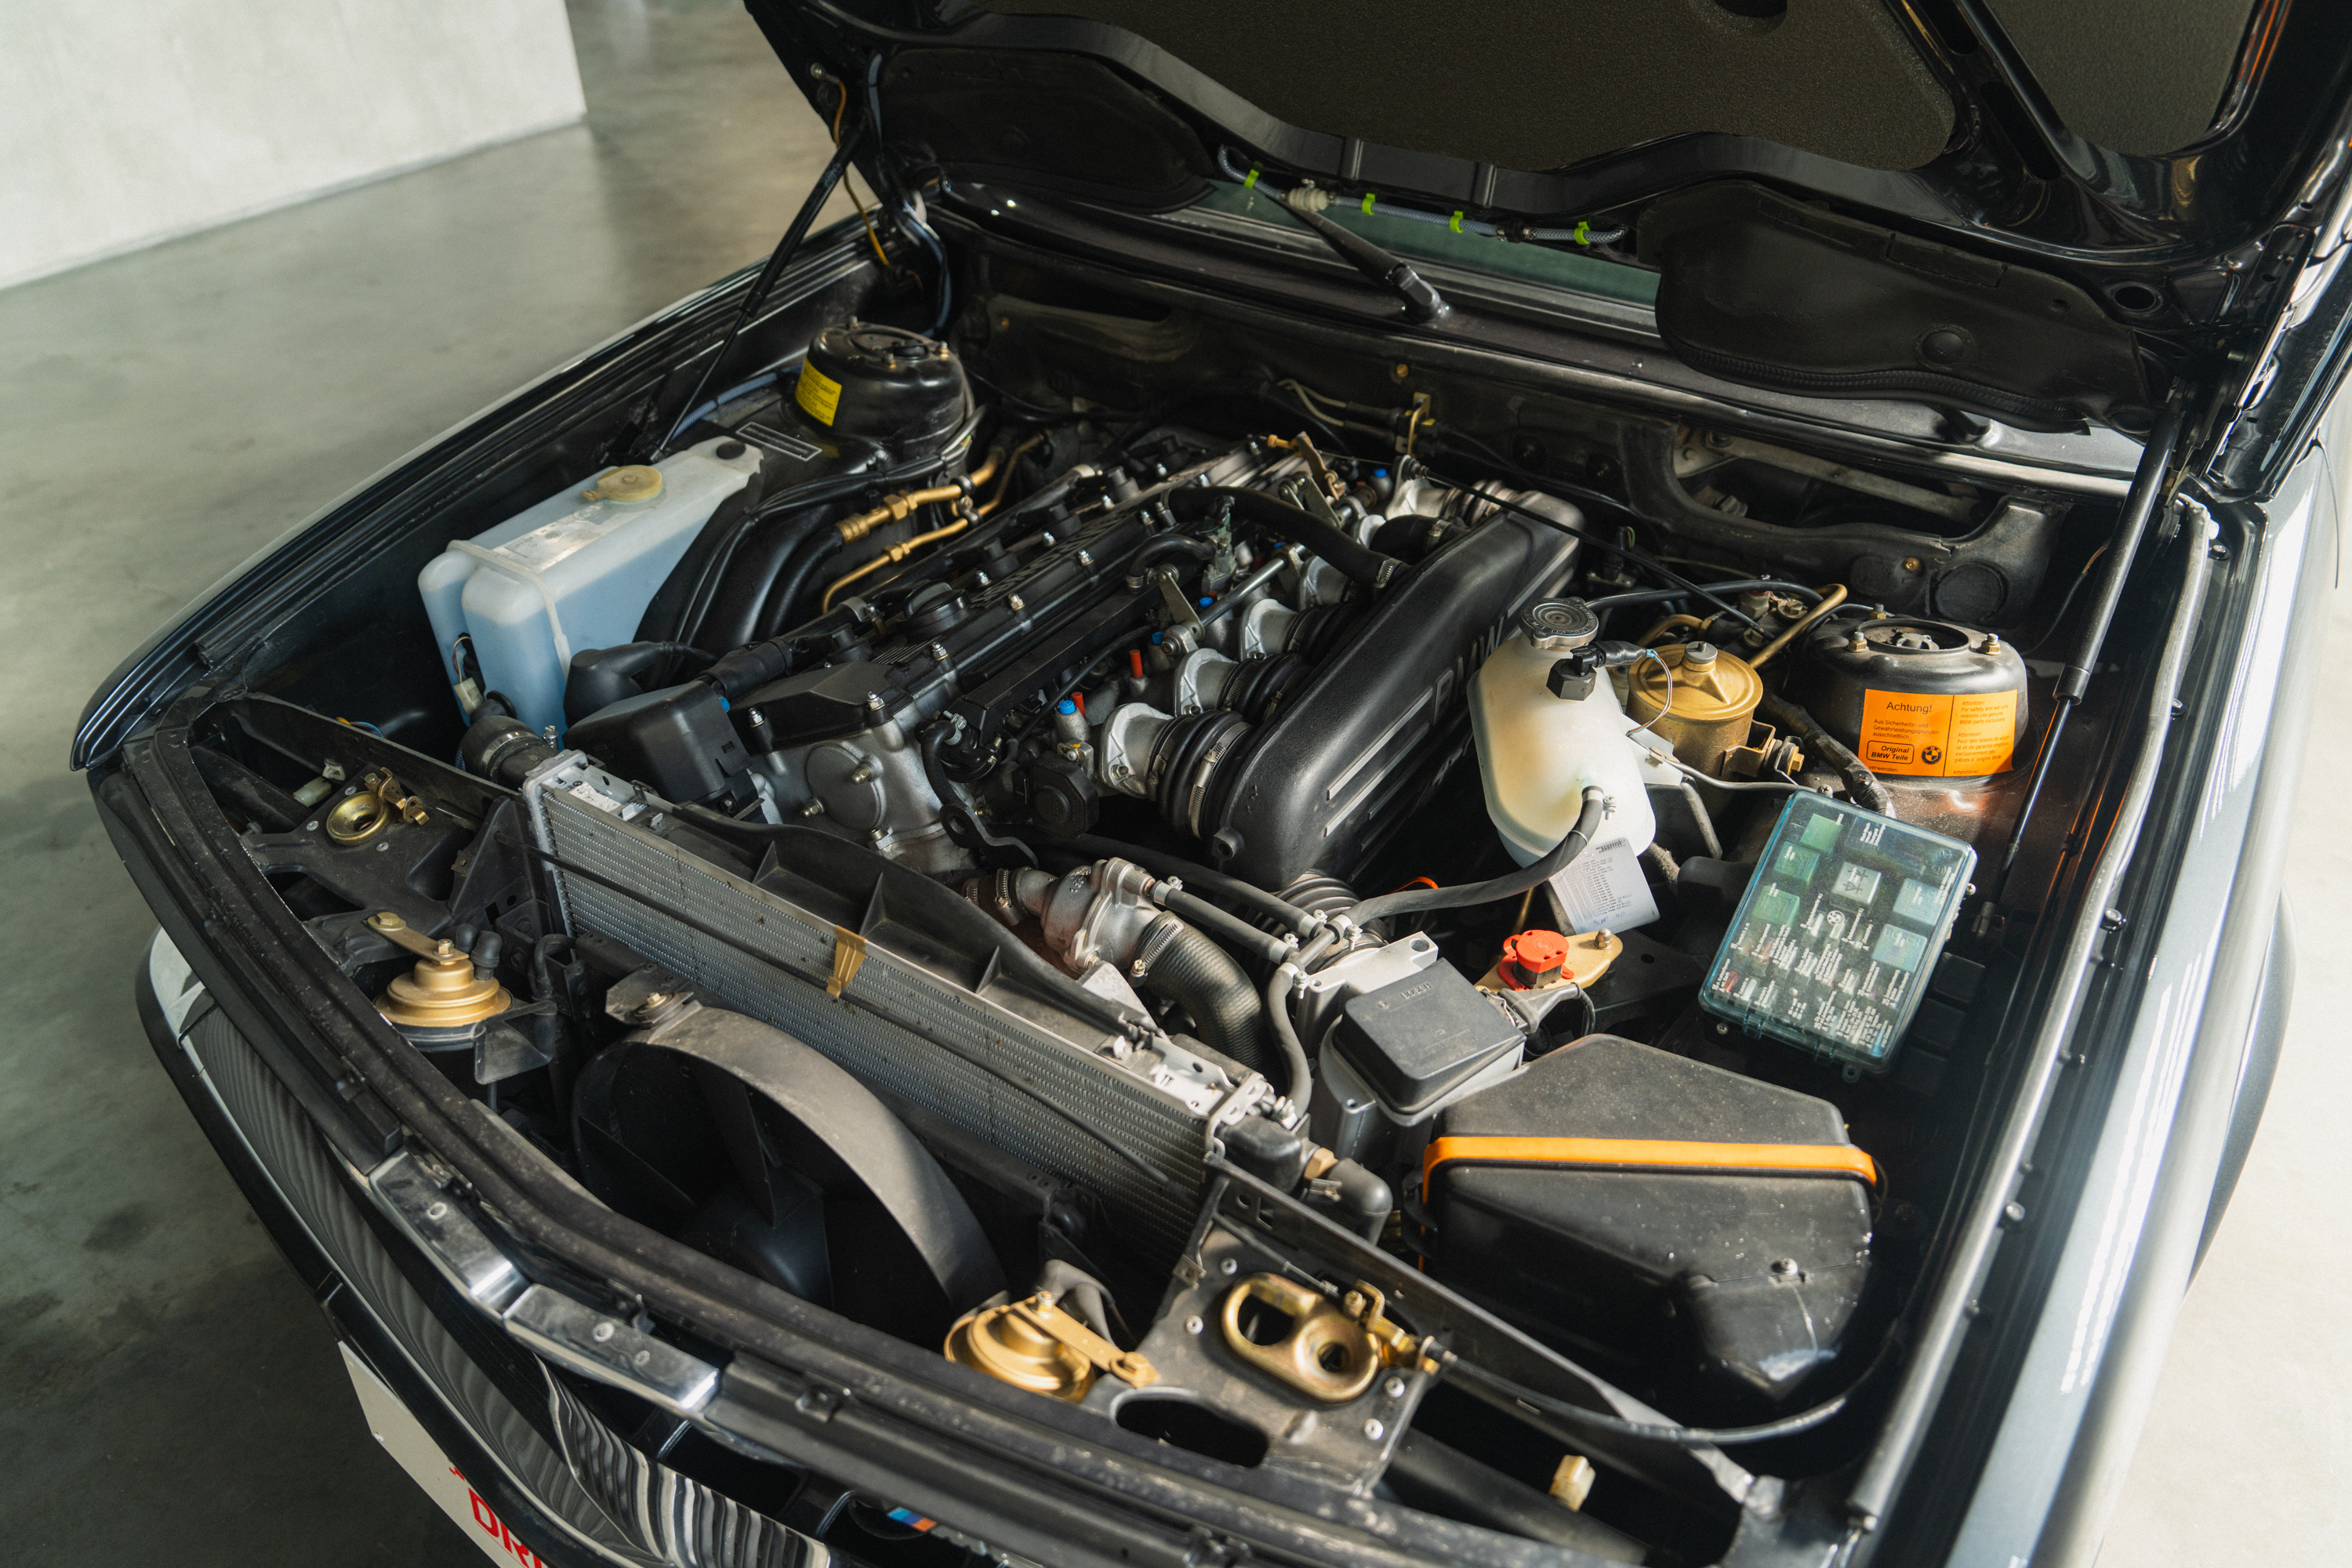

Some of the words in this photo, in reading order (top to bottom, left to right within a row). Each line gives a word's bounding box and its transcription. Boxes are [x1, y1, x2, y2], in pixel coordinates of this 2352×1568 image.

[1886, 702, 1932, 714] Achtung!
[1874, 725, 1939, 735] Gewährleistungsgründen
[1400, 982, 1432, 1000] BOSCH
